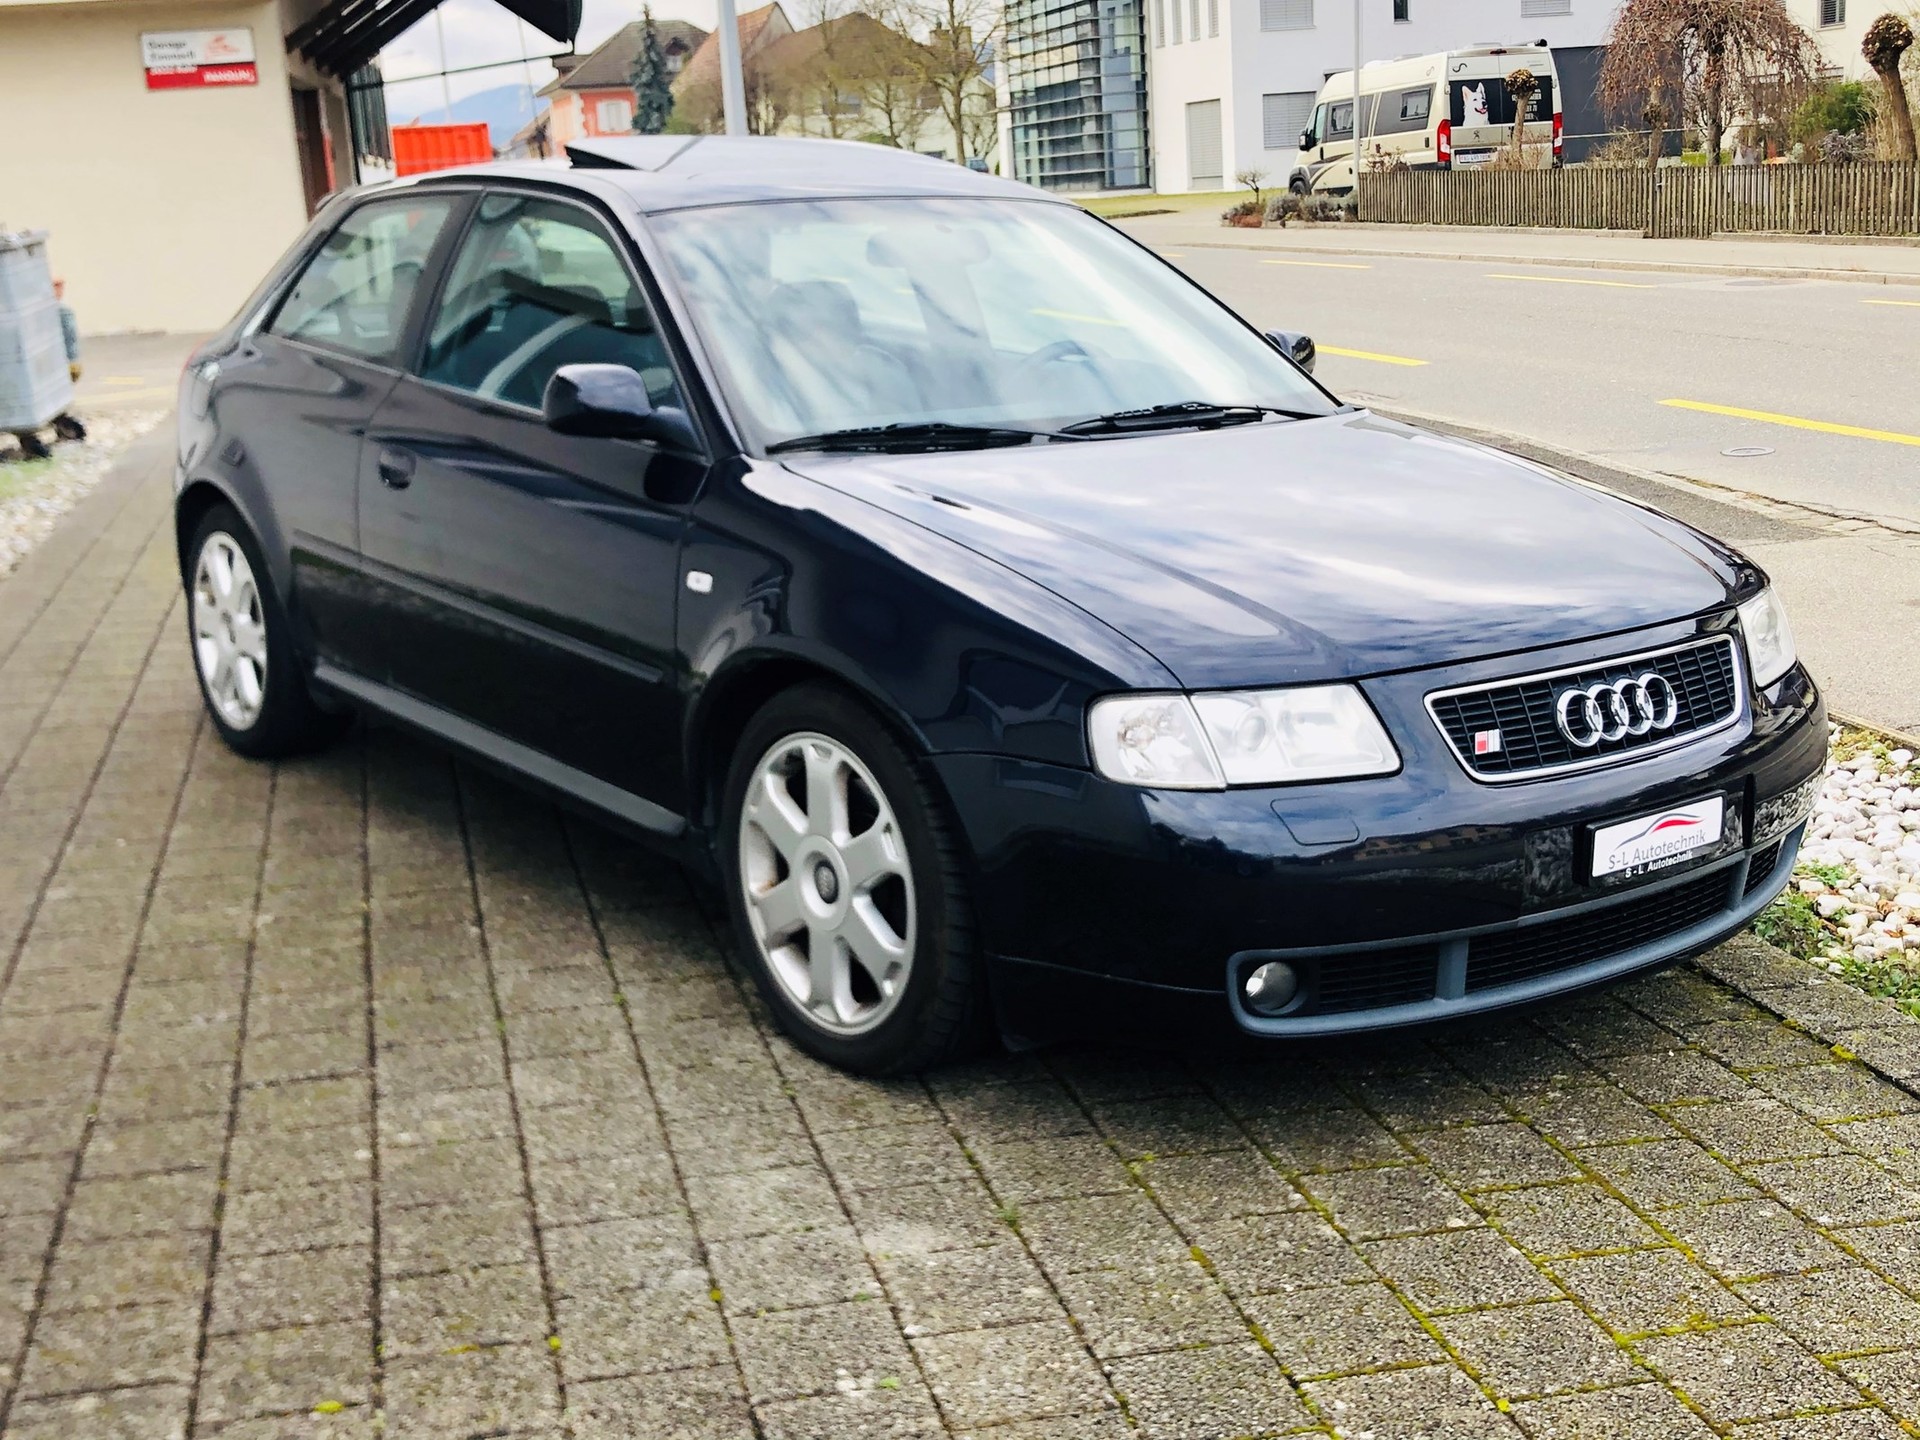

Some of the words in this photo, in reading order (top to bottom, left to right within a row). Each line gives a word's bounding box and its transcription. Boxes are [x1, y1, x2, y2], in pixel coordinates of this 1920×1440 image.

[1608, 852, 1629, 870] S-L
[1632, 829, 1706, 863] Autotechnik
[1647, 851, 1693, 871] Autotechnik
